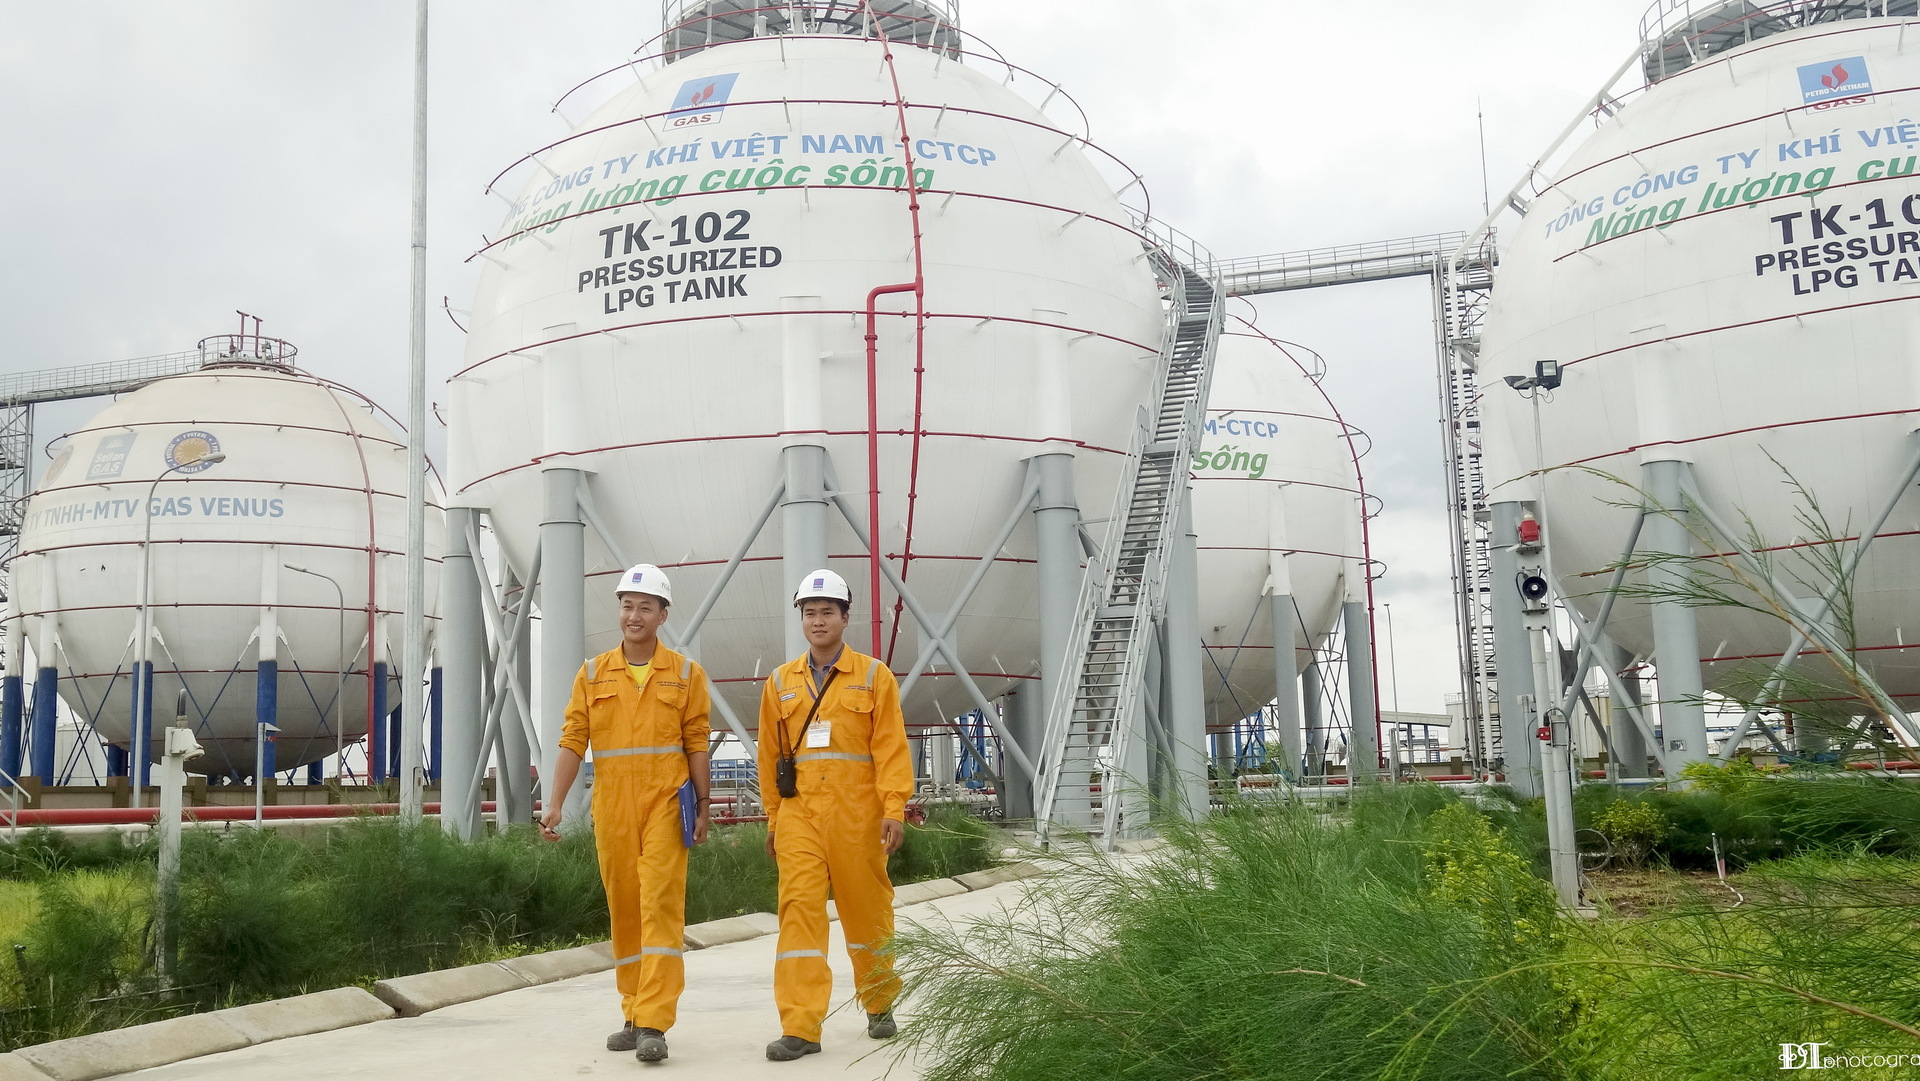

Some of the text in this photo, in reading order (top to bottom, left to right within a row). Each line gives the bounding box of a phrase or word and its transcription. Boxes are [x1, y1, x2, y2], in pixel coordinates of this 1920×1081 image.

[673, 114, 712, 127] GAS
[532, 166, 594, 206] CÔNG
[602, 153, 638, 180] TY
[645, 137, 703, 169] KHÍ
[710, 132, 789, 163] VIỆT
[801, 134, 885, 155] NAM
[915, 139, 997, 167] CTCP
[1612, 164, 1699, 206] CÔNG
[1716, 148, 1761, 175] TY
[1778, 128, 1841, 162] KHÍ
[1857, 118, 1920, 150] VIỆ
[502, 156, 935, 252] Năng lượng cuộc sống
[1583, 155, 1920, 248] Năng lượng cu
[598, 209, 751, 259] TK-102
[1755, 230, 1920, 277] PRESSUR
[577, 246, 783, 294] PRESSURIZED
[1792, 257, 1920, 296] LPG TA
[604, 274, 749, 315] LPG TANK
[91, 462, 122, 474] GAS
[1191, 444, 1268, 479] sống
[44, 498, 140, 527] TNHH-MTV
[146, 496, 193, 517] GAS
[200, 496, 284, 518] VENUS
